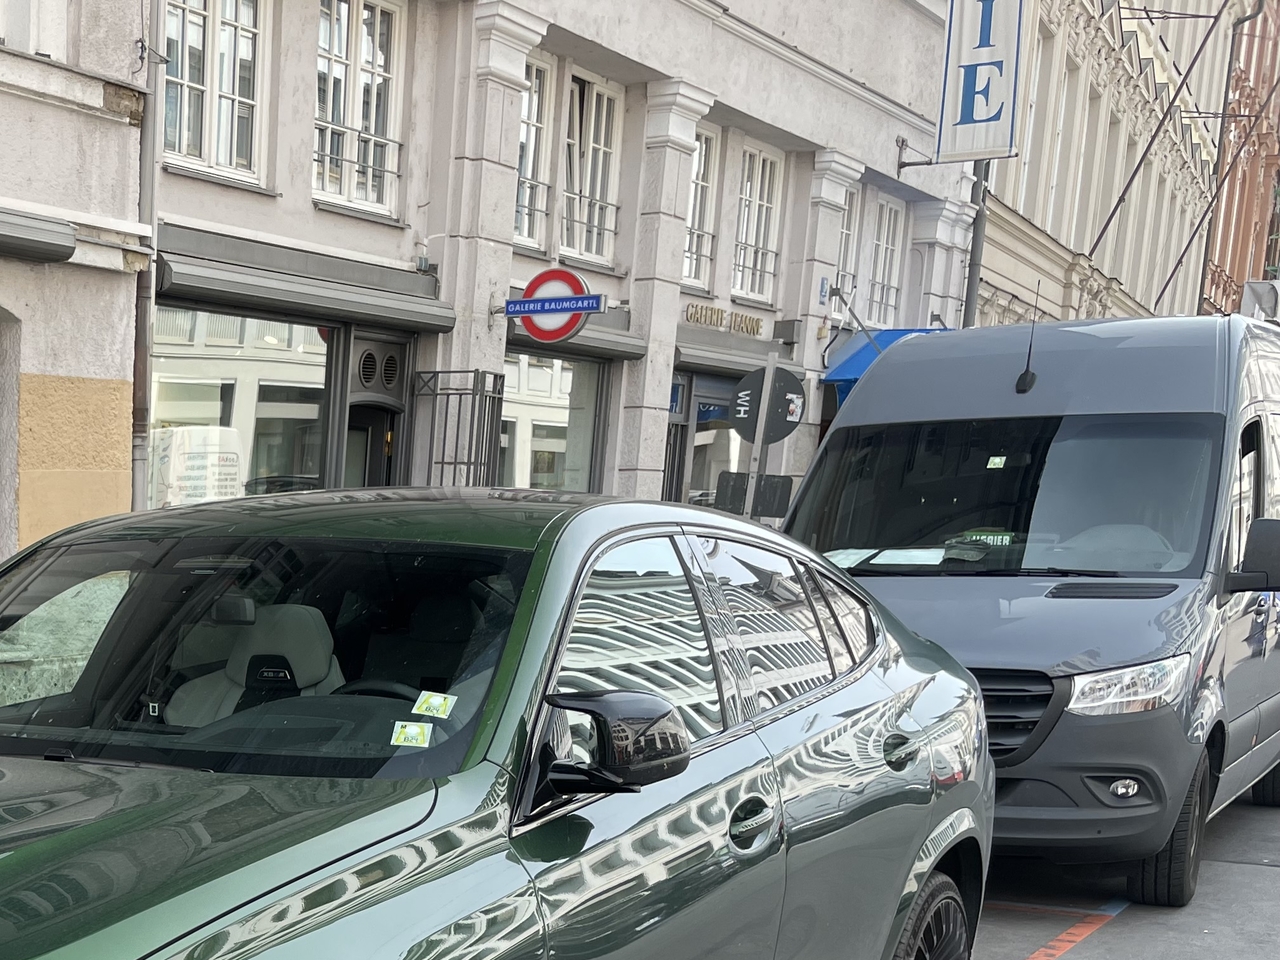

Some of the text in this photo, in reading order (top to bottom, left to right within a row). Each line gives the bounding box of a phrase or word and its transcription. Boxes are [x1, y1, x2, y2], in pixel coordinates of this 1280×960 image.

[508, 299, 598, 312] GALERIE BAUMGARTL
[685, 302, 764, 337] GALERIE JEANNE
[735, 390, 752, 418] WH
